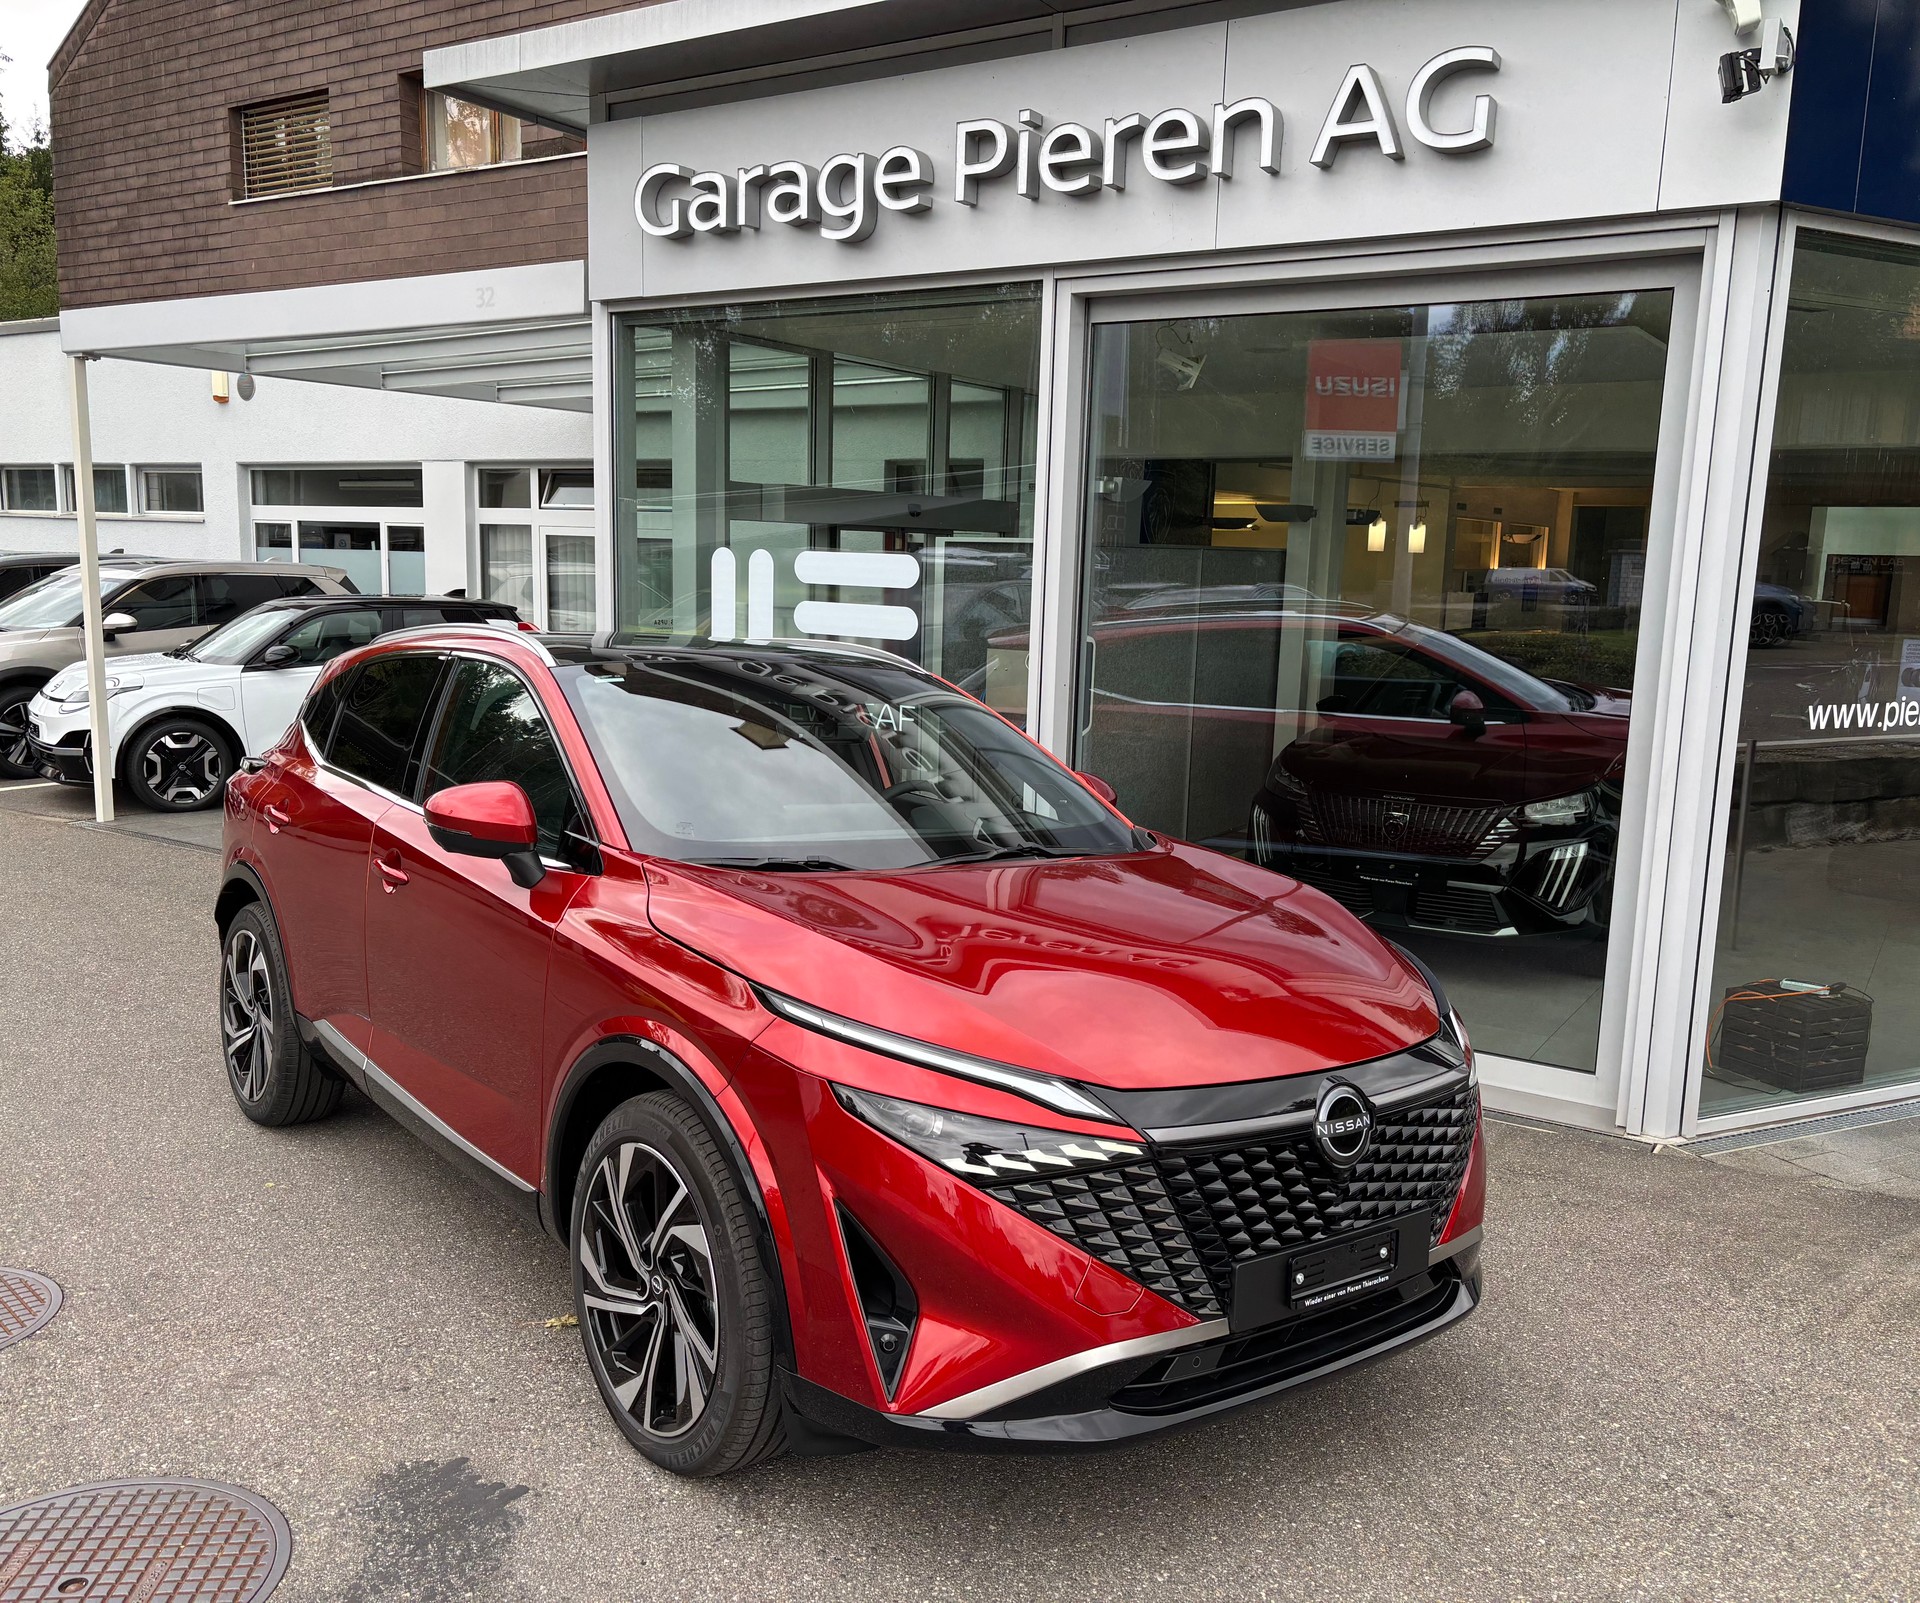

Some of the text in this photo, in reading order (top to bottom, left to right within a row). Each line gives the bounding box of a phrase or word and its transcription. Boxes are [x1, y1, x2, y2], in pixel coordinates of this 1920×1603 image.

[634, 45, 1502, 243] Garage Pieren AG
[475, 286, 496, 309] 32
[865, 702, 916, 732] AF
[1808, 695, 1920, 731] www.pie
[1316, 1113, 1371, 1136] NISSAN
[1304, 1297, 1323, 1306] Wieder
[1324, 1292, 1336, 1300] einer
[1347, 1284, 1361, 1293] Pieren
[663, 1422, 717, 1469] MICHELI
